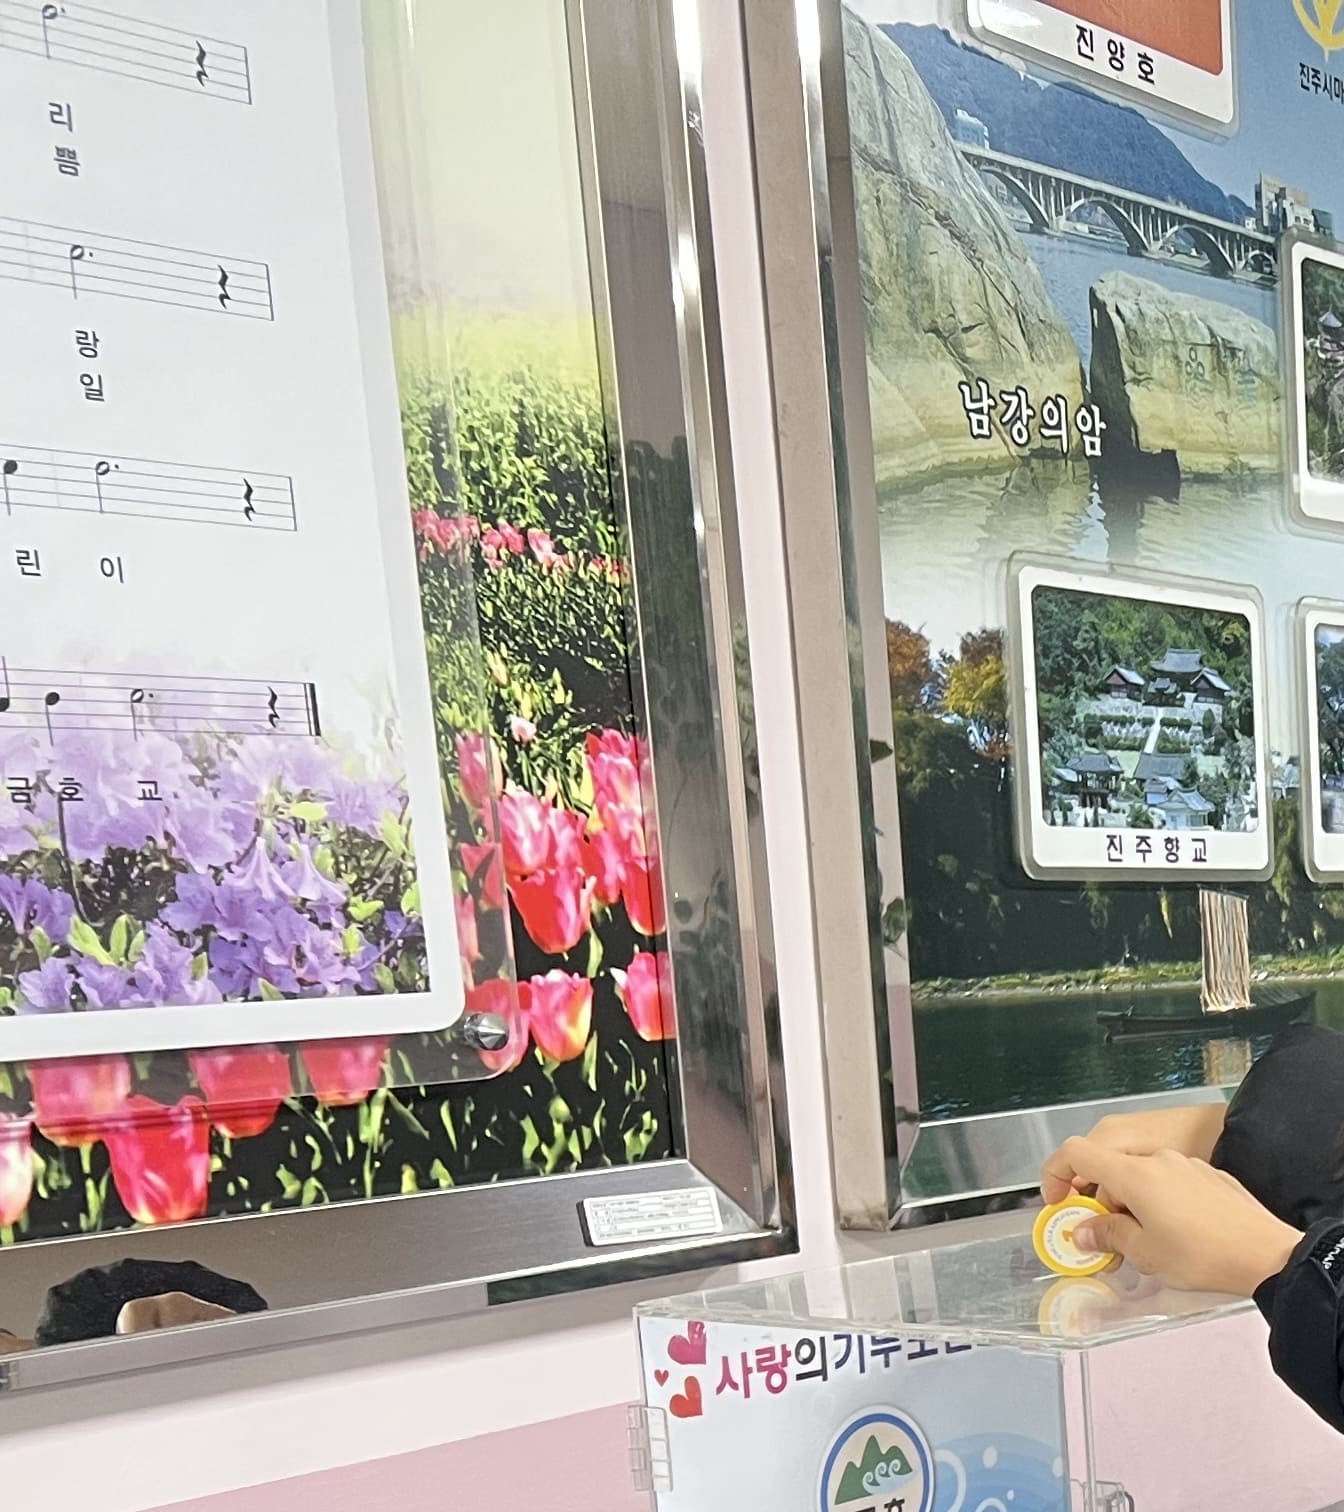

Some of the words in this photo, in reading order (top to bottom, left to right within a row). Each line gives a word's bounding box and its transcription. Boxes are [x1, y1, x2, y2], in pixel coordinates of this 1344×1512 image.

[1074, 23, 1156, 86] 진양호
[48, 101, 74, 133] 리
[53, 144, 81, 177] 쁨
[74, 329, 100, 361] 랑
[78, 372, 105, 403] 일
[959, 377, 1108, 458] 남강의암
[14, 548, 42, 578] 린
[99, 555, 126, 585] 이
[6, 774, 34, 805] 금
[57, 776, 84, 804] 호
[136, 778, 163, 803] 교
[1106, 834, 1208, 864] 진주향교
